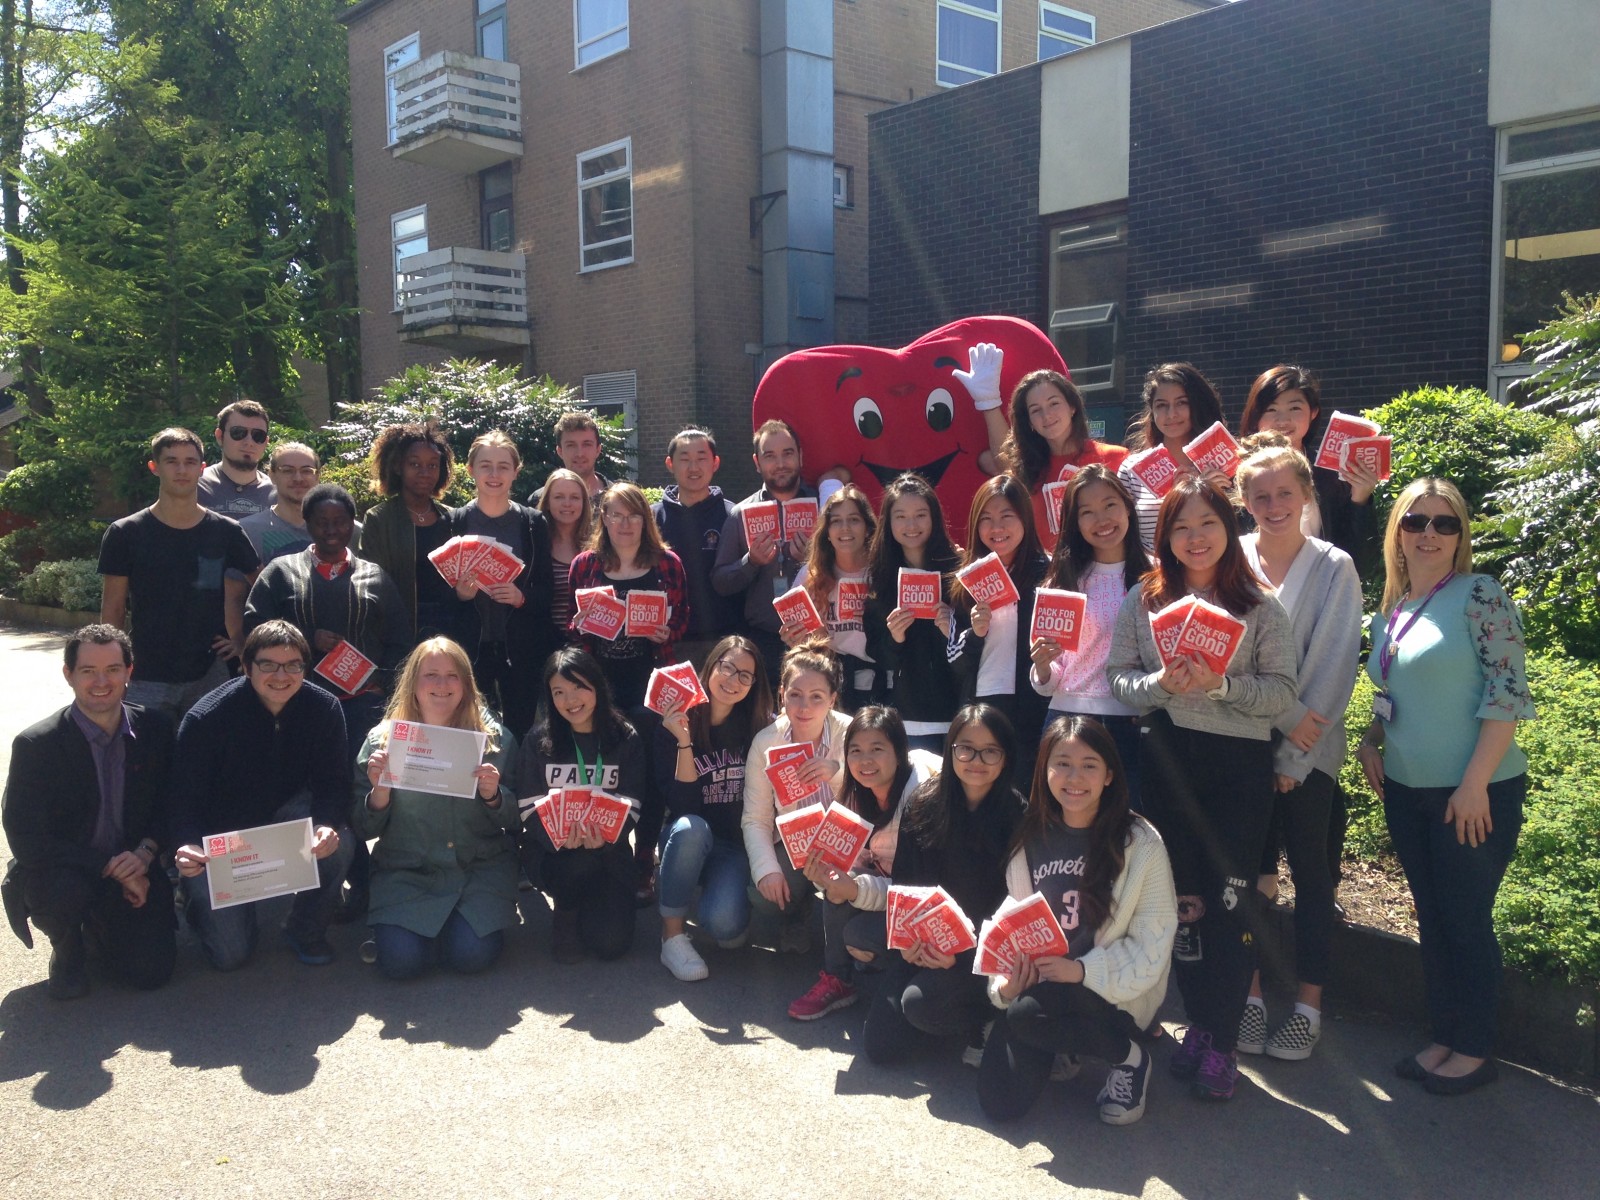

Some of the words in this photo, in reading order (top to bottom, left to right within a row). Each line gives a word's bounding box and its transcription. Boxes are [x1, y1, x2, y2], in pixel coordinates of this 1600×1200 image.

[1329, 430, 1348, 440] PACK
[1196, 451, 1215, 466] PACK
[1212, 441, 1227, 454] FOR
[1325, 438, 1342, 453] GO
[1355, 447, 1364, 460] OR
[1141, 463, 1159, 479] PACK
[1157, 456, 1171, 468] FOR
[1364, 447, 1378, 472] OOD
[1146, 460, 1175, 486] GOOD
[749, 521, 775, 534] GOOD
[786, 518, 813, 528] GOOD
[443, 563, 456, 576] GO
[480, 560, 506, 580] GOOD
[485, 554, 500, 566] PACK
[499, 564, 509, 573] FOR
[969, 579, 987, 593] PACK
[985, 572, 1000, 583] FOR
[974, 579, 1005, 602] GOOD
[841, 599, 863, 610] GOO
[902, 591, 934, 603] GOOD
[589, 609, 618, 627] GOOD
[593, 602, 607, 613] PACK
[607, 609, 620, 618] FOR
[630, 610, 658, 622] GOOD
[780, 608, 795, 618] PACK
[794, 602, 806, 611] FOR
[1038, 607, 1057, 617] PACK
[1059, 609, 1075, 619] FOR
[1036, 615, 1074, 632] GOOD
[1156, 625, 1180, 639] PACK
[1191, 618, 1212, 635] PACK
[1212, 629, 1231, 644] FOR
[1160, 634, 1179, 653] GO
[1185, 628, 1227, 657] GOOD
[332, 650, 358, 678] GOOD
[661, 687, 679, 708] OOD
[777, 769, 788, 784] FOR
[784, 765, 805, 797] GOOD
[785, 782, 796, 800] PACK
[566, 801, 584, 809] PACK
[605, 808, 619, 819] FOR
[566, 809, 586, 821] GO
[786, 830, 806, 843] PACK
[824, 821, 842, 836] PACK
[843, 832, 858, 845] FOR
[789, 835, 813, 854] GOO
[818, 829, 854, 856] GOOD
[896, 908, 910, 916] PAC
[1061, 890, 1080, 930] 3
[926, 916, 952, 953] GOOD
[1010, 924, 1030, 939] PACK
[1029, 917, 1047, 931] FOR
[946, 931, 960, 947] FOR
[997, 938, 1010, 955] PAC
[1018, 926, 1055, 949] GOOD
